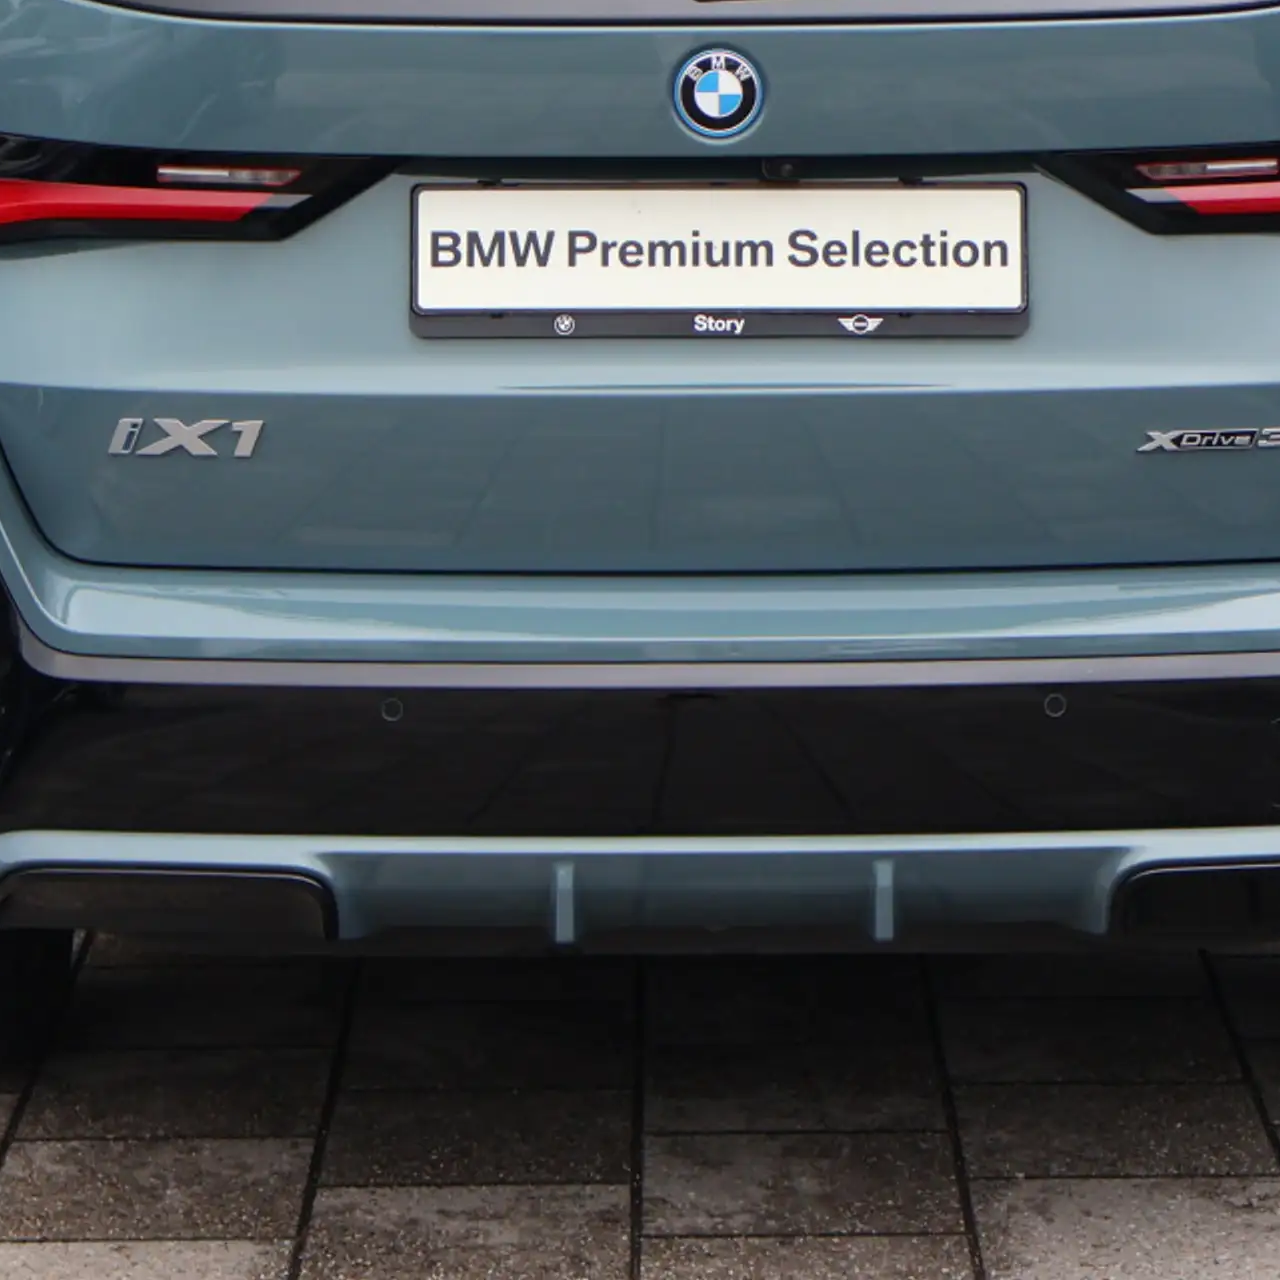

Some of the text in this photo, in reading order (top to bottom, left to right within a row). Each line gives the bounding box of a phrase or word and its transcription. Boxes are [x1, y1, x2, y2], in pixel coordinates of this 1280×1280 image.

[429, 228, 1010, 268] BMW Premium Selection
[693, 314, 745, 334] Story
[108, 417, 265, 458] iX1
